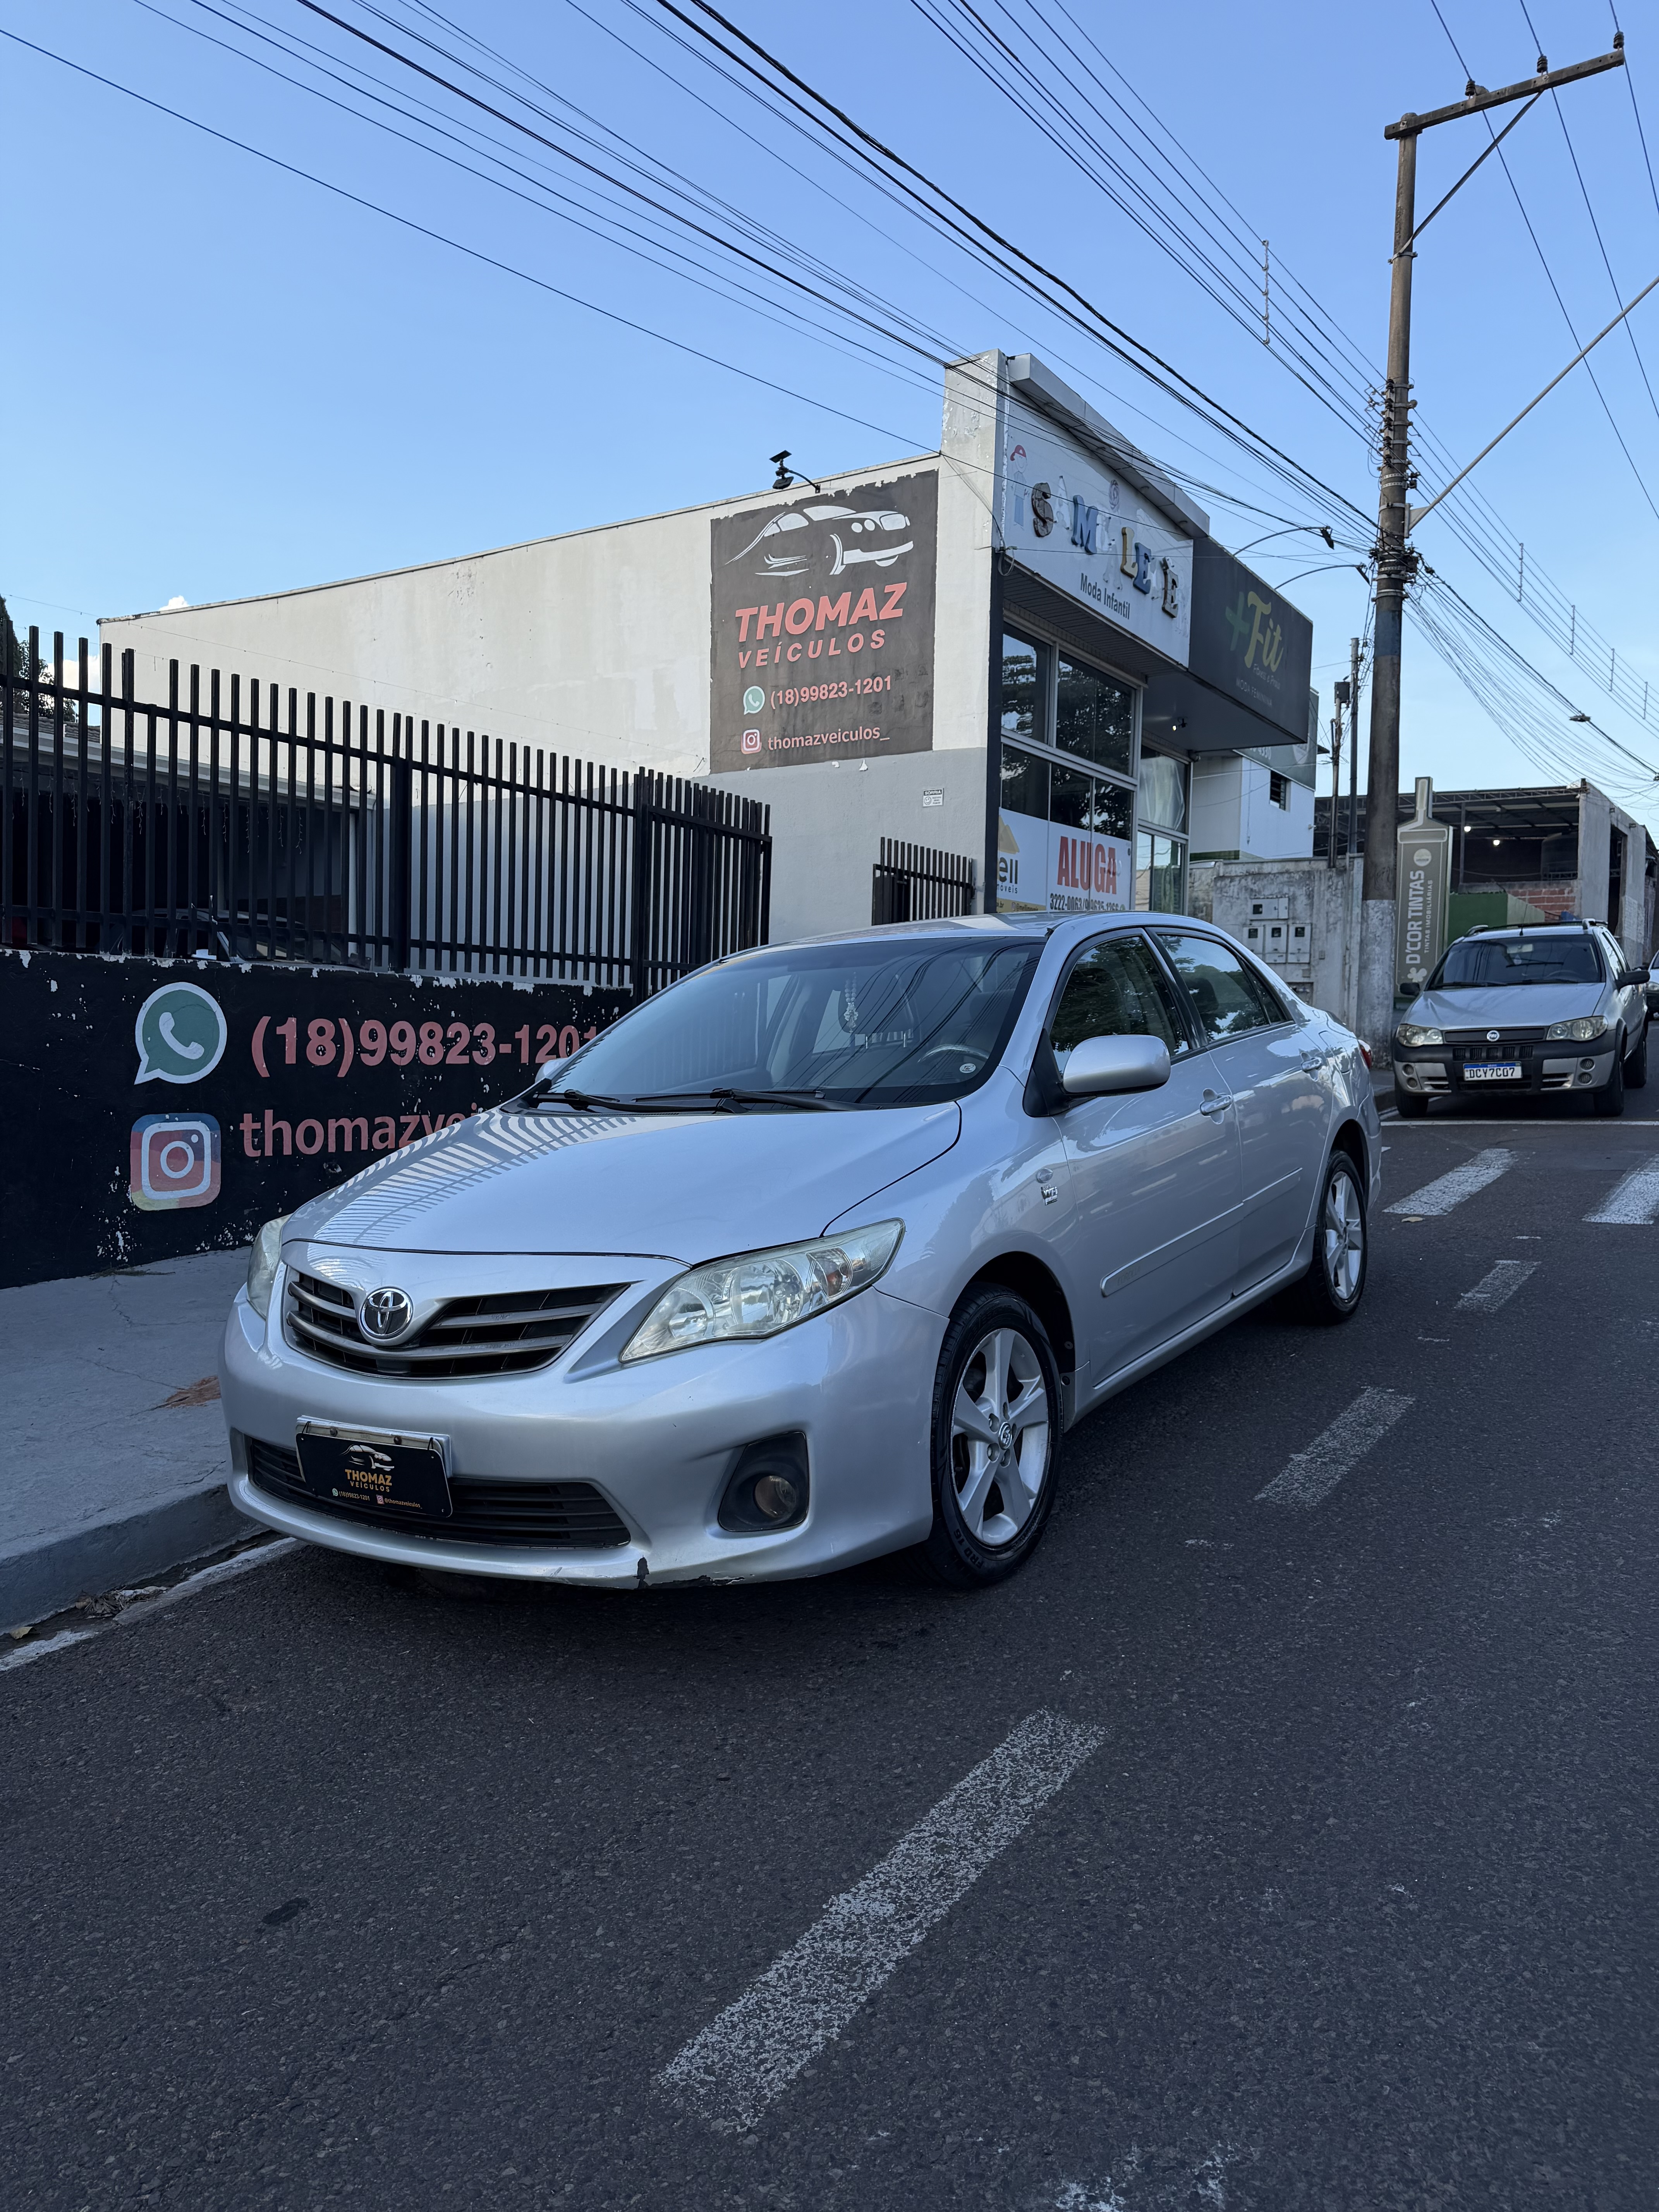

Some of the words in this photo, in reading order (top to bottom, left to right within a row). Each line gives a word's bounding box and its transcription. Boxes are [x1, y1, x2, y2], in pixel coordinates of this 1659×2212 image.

[735, 582, 907, 642] THOMAZ
[1080, 573, 1101, 602] Moda
[1104, 588, 1130, 620] Infantil
[739, 629, 886, 669] VEÍCULOS
[771, 675, 891, 709] (18)99823-1201
[768, 726, 890, 750] thomazveiculos_
[1057, 836, 1117, 895] ALUGA
[1408, 870, 1425, 919] TINTAS
[1406, 921, 1422, 964] D'COR
[1469, 1067, 1515, 1079] DCY7C07
[345, 1469, 392, 1486] THOMAZ
[350, 1480, 390, 1492] VEÍCULOS
